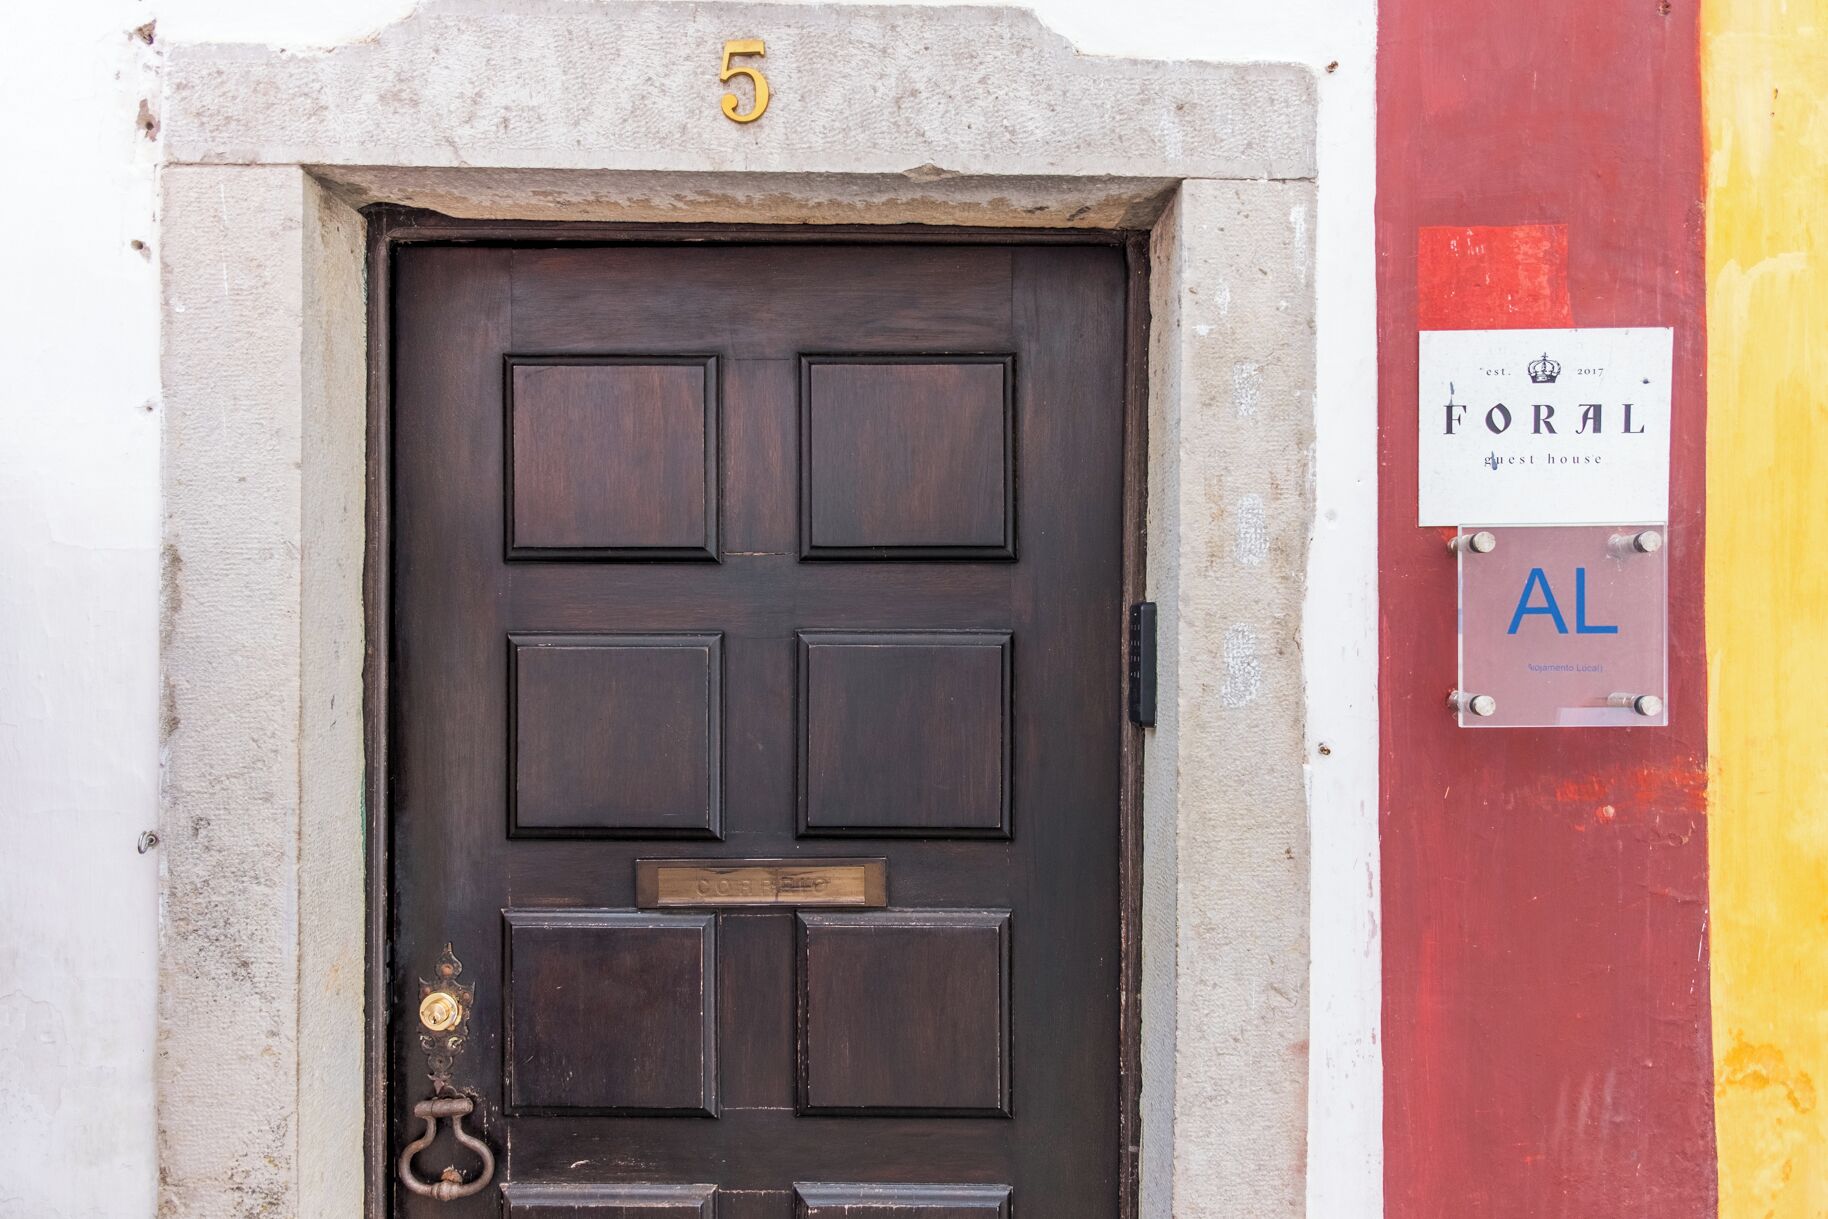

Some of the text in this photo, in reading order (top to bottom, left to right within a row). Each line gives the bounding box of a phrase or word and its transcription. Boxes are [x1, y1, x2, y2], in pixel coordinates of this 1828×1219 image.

[719, 40, 770, 124] 5
[1486, 367, 1604, 378] est. 2017
[1443, 402, 1646, 435] FORAL
[1484, 453, 1602, 467] guest house
[1507, 567, 1618, 634] AL
